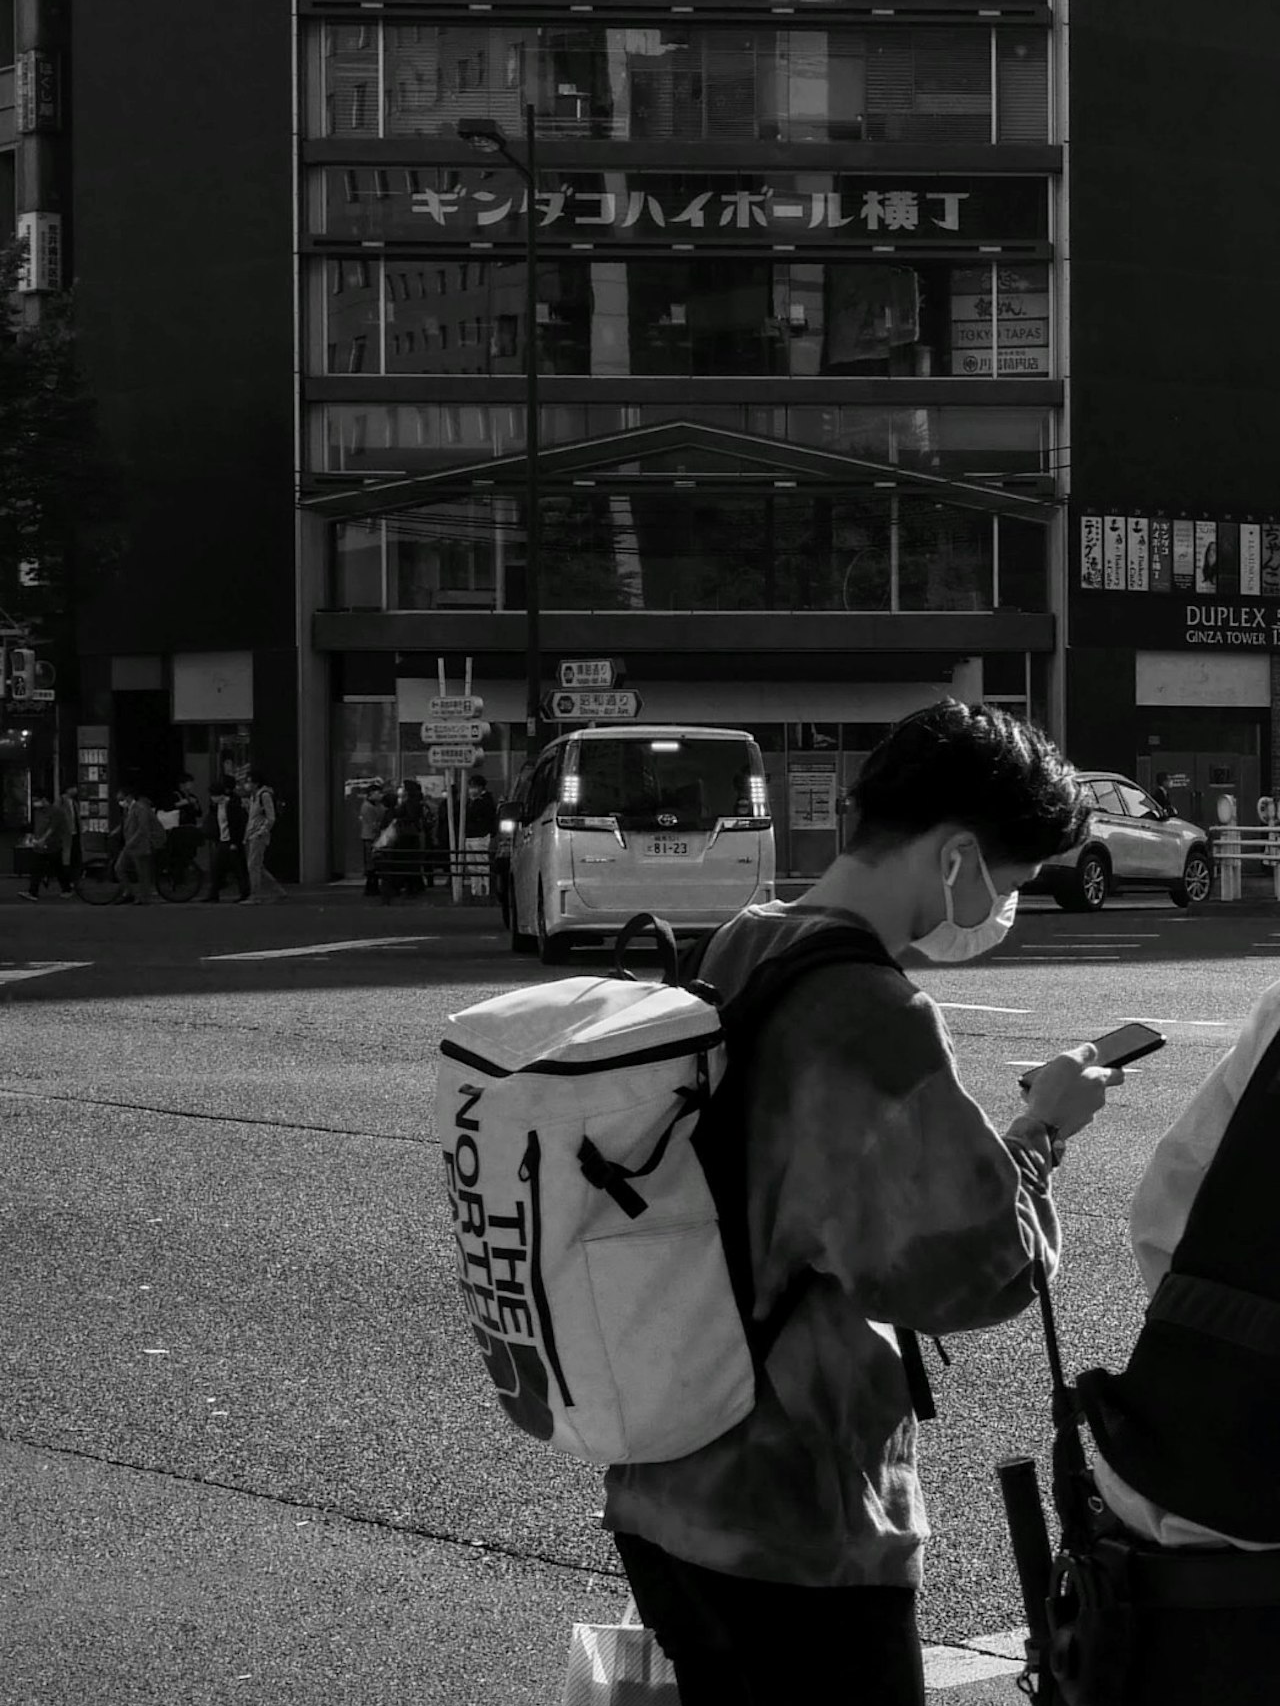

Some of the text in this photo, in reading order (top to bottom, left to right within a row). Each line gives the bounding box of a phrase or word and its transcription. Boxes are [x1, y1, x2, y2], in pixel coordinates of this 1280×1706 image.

[411, 188, 971, 231] ギンダコハイボール横丁
[1185, 605, 1266, 629] DUPLEX
[1185, 630, 1223, 644] GINZA
[1225, 631, 1265, 646] TOWER
[654, 843, 688, 854] 81-23
[455, 1083, 502, 1333] NORTH
[487, 1200, 535, 1338] THE
